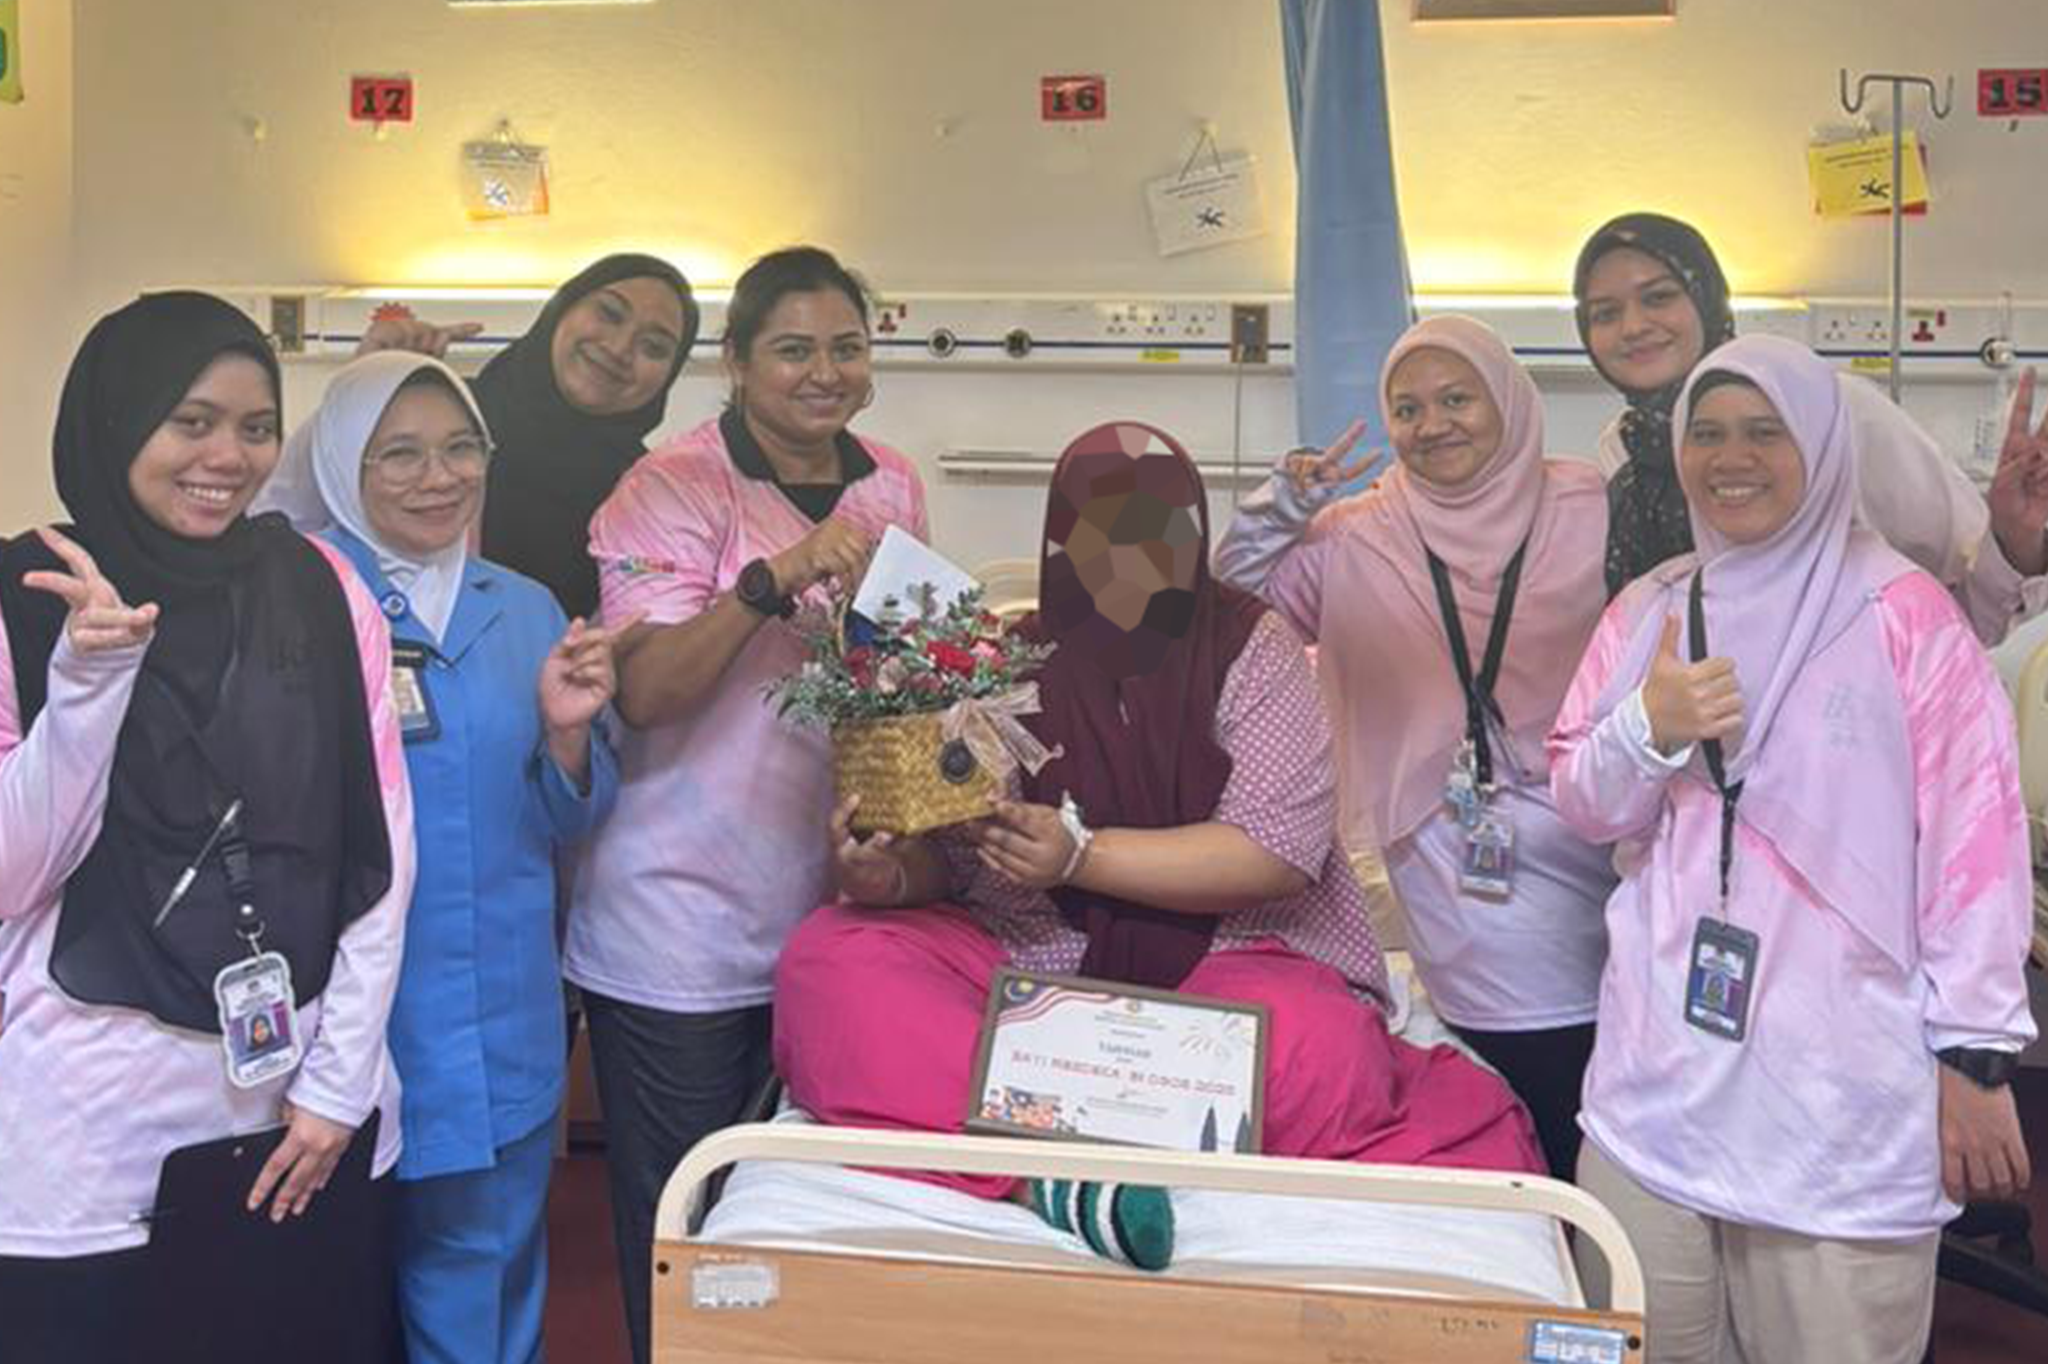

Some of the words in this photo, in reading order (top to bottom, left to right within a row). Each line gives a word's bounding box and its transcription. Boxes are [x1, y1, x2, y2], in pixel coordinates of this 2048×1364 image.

[361, 86, 405, 114] 17
[1053, 85, 1098, 112] 16
[1988, 77, 2042, 108] 15
